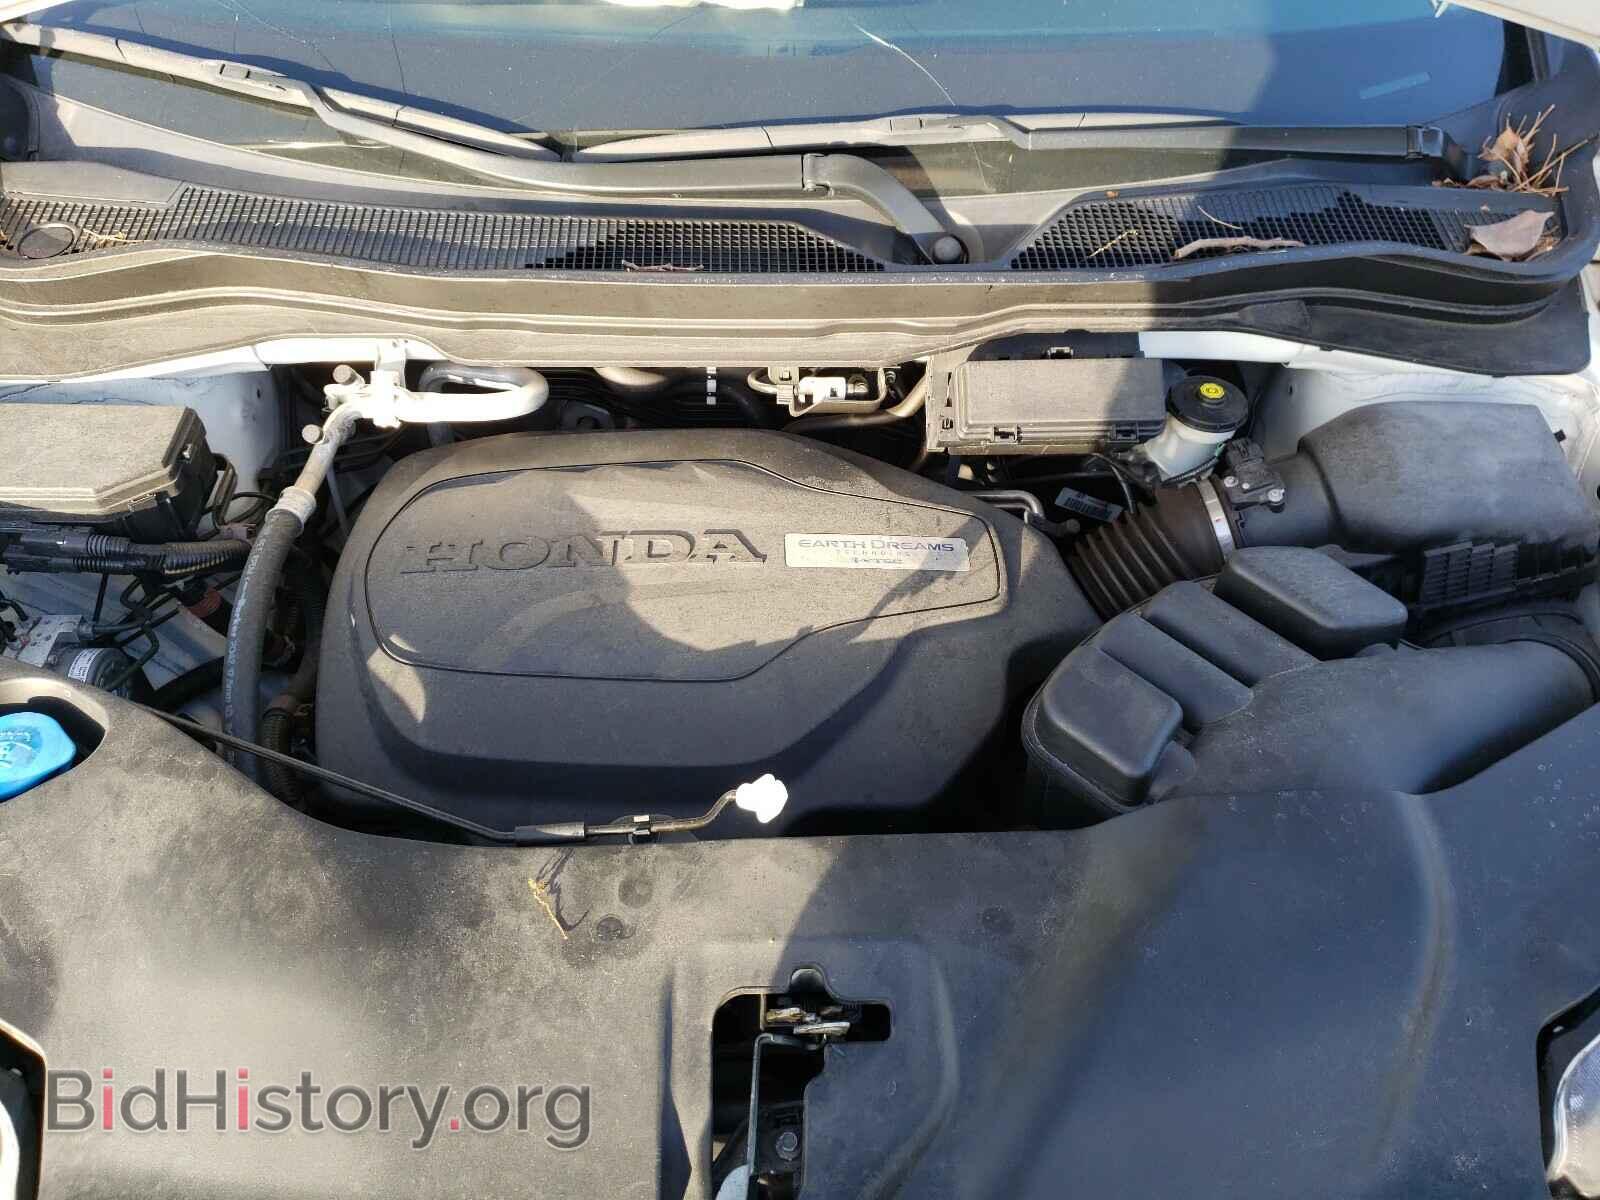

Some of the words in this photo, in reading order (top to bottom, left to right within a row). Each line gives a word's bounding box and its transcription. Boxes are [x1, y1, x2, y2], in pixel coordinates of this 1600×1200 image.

[399, 529, 768, 574] HONDA
[798, 538, 866, 549] EARTH
[871, 538, 955, 552] DREAMS
